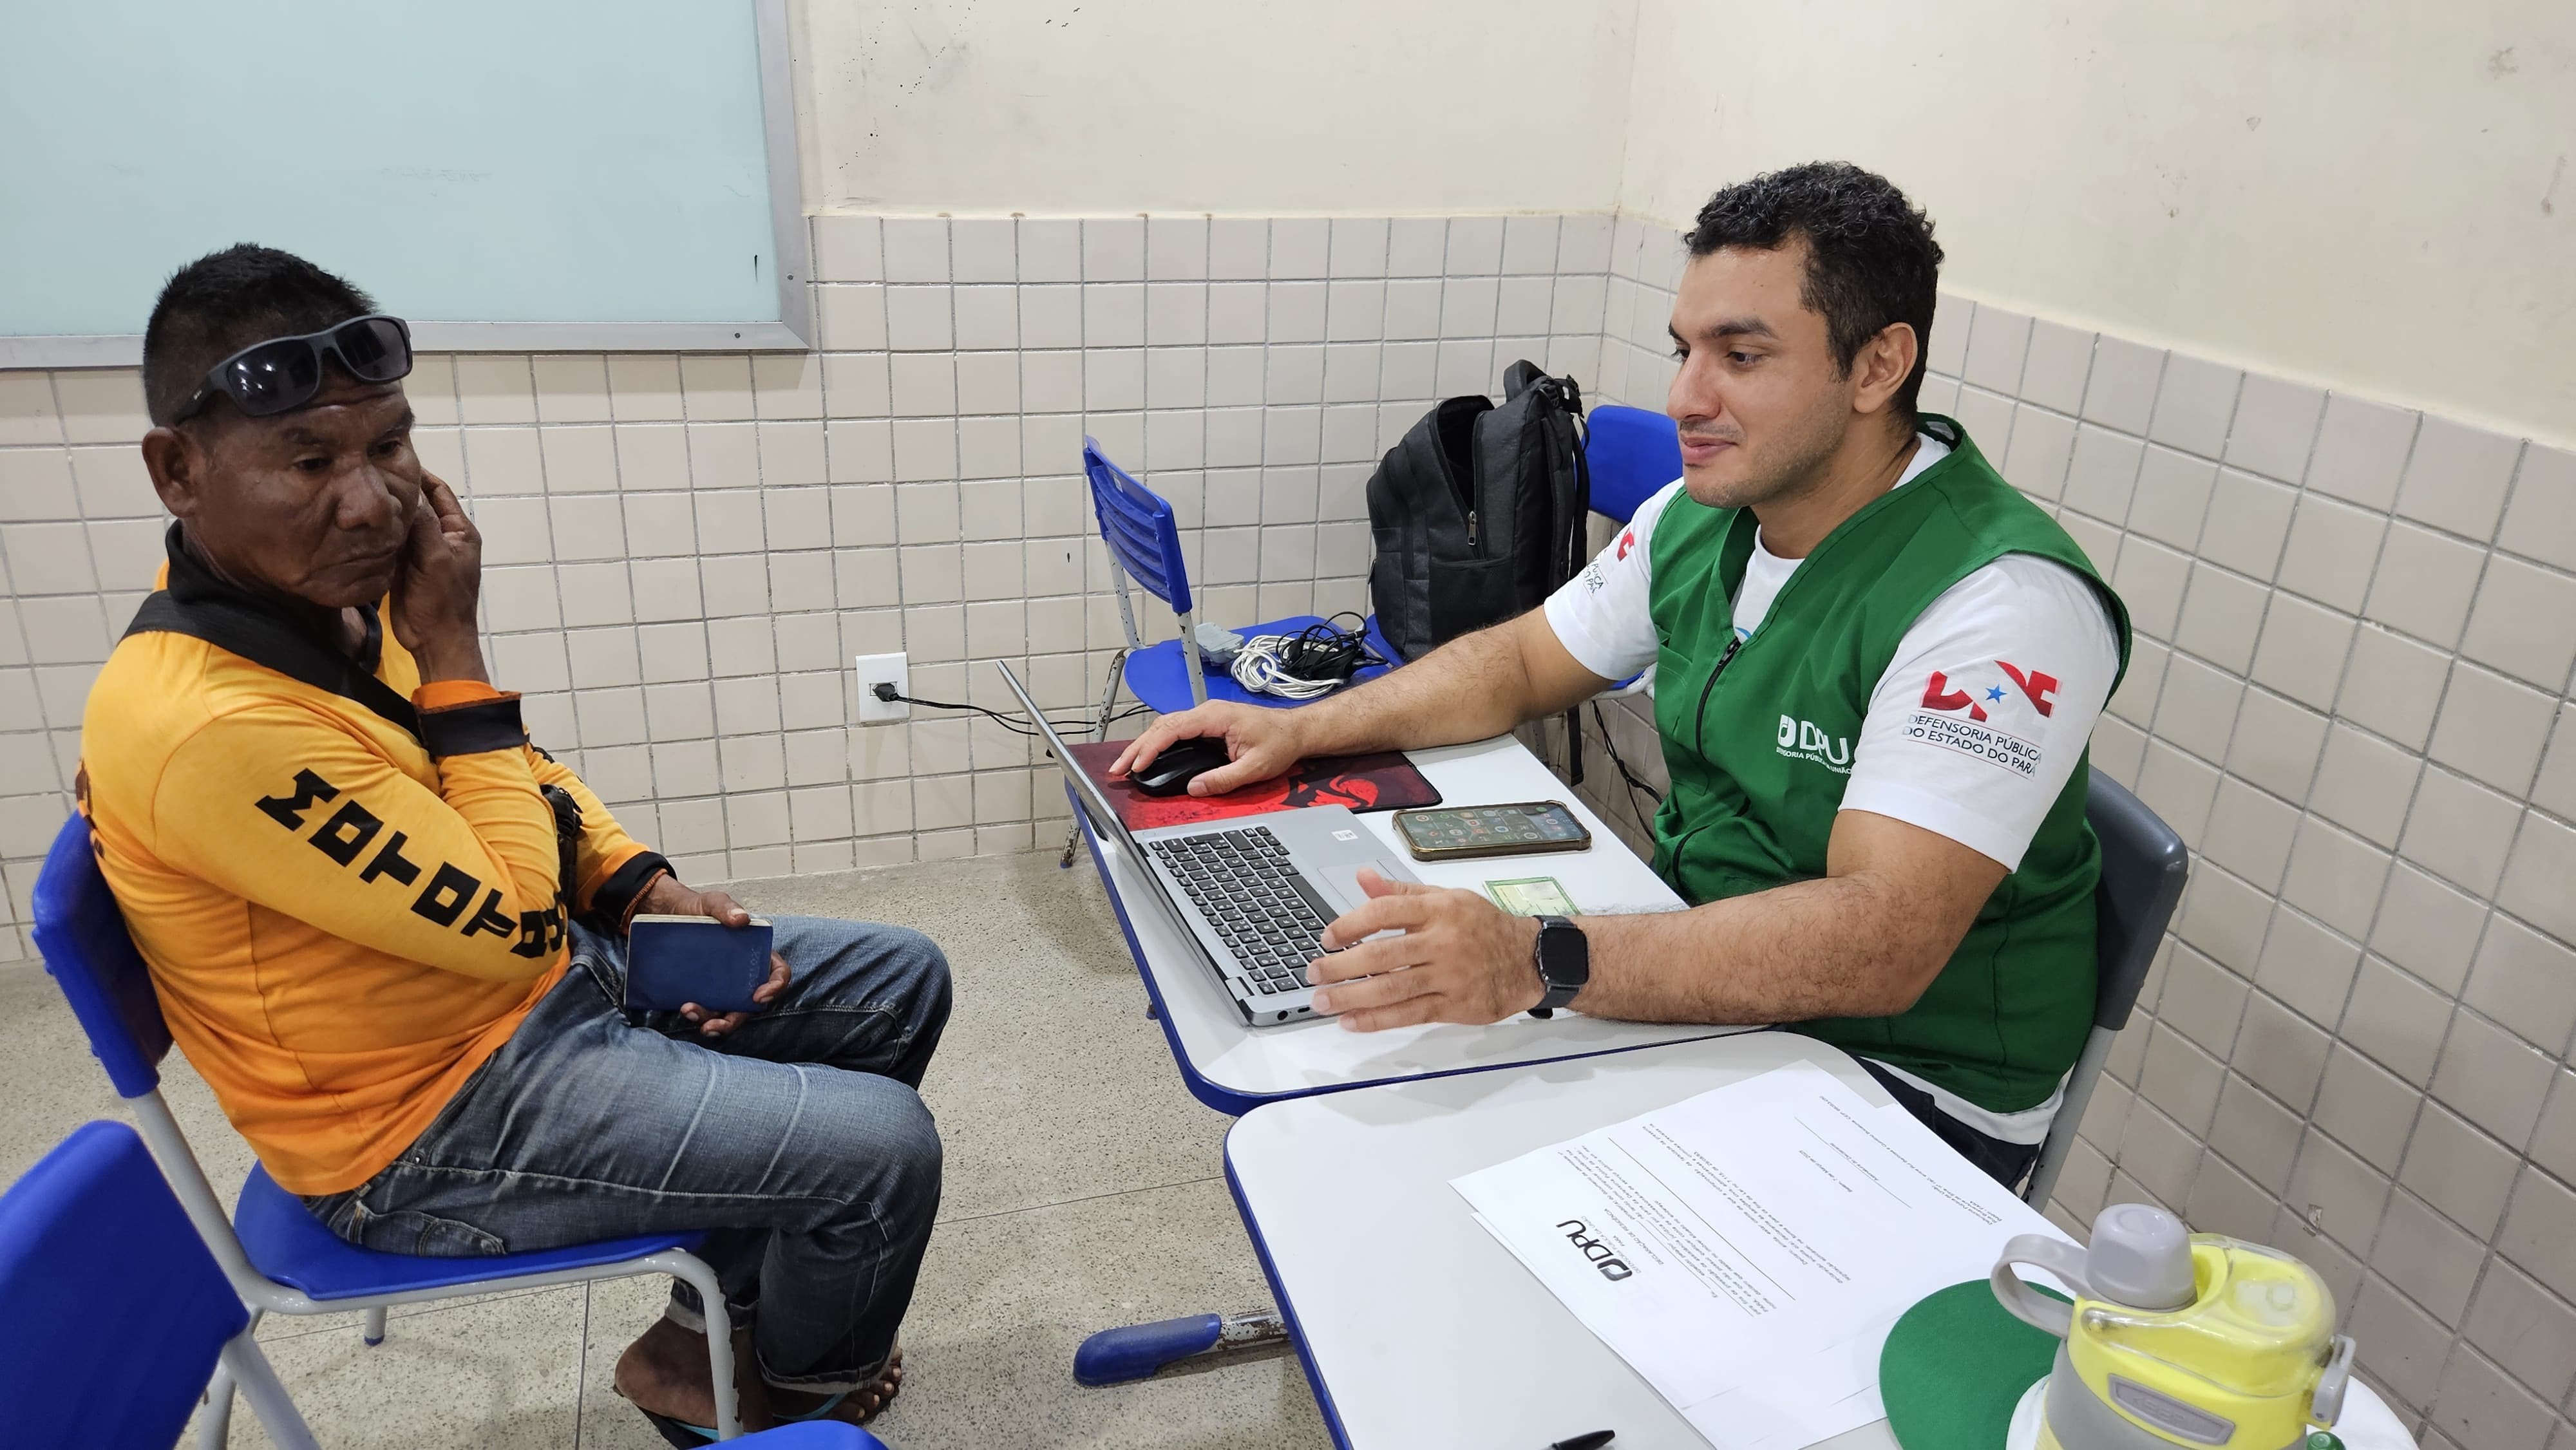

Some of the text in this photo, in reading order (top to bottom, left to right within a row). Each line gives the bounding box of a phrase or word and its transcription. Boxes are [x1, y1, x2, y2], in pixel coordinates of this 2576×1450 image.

[1799, 720, 1850, 765] DPU
[1908, 714, 2043, 764] DEFENSORIA PÚBLICA
[1902, 726, 2036, 778] DO ESTADO DO PARÁ
[1604, 1208, 1629, 1232] RESIDÊNCIA
[1758, 1225, 1771, 1235] estar
[1556, 1219, 1614, 1262] DPU
[1633, 1237, 1664, 1265] DECLARAÇÃO
[1722, 1272, 1732, 1281] não
[1733, 1272, 1743, 1280] que
[1732, 1281, 1743, 1290] que
[1738, 1296, 1748, 1304] fins
[1748, 1305, 1761, 1315] para
